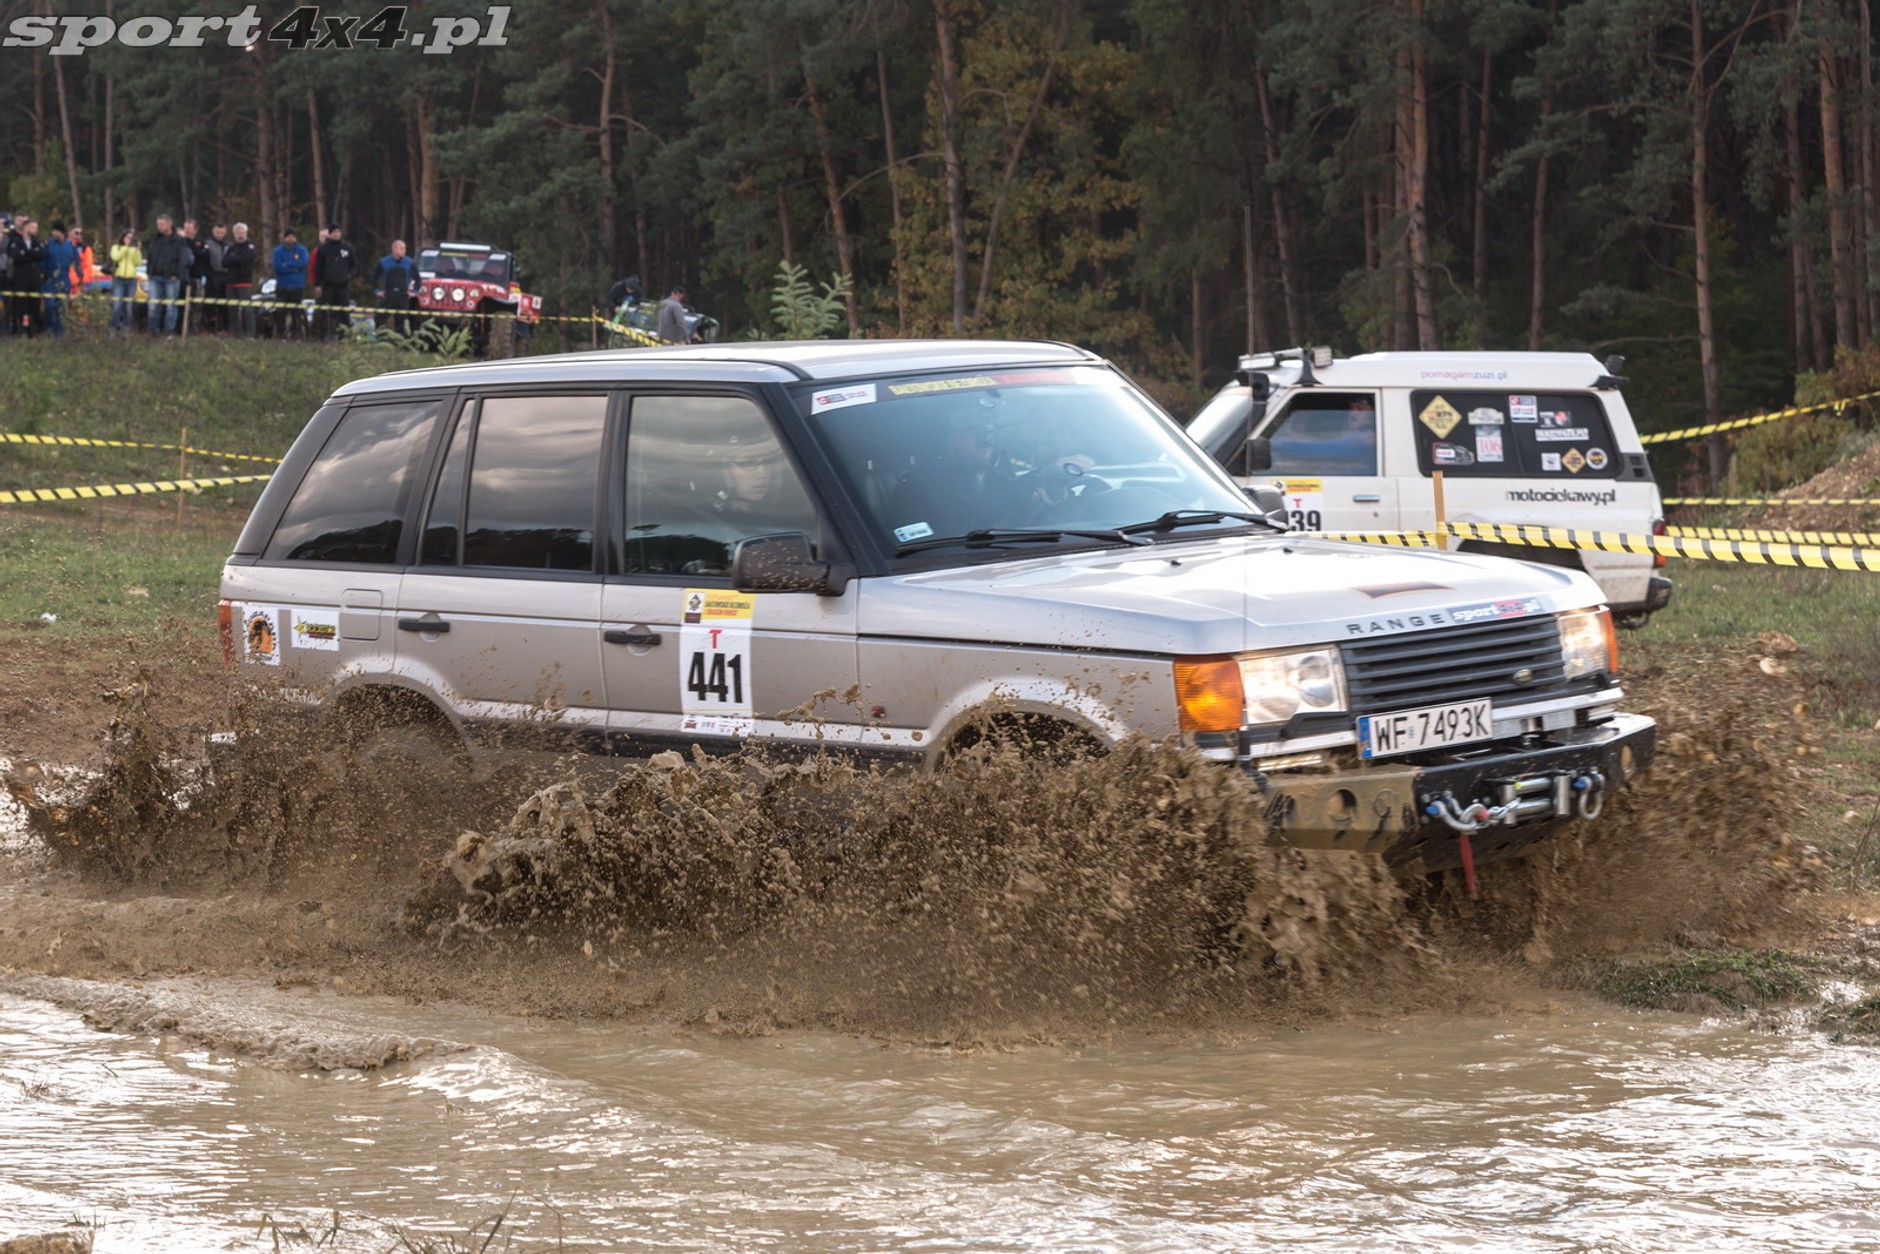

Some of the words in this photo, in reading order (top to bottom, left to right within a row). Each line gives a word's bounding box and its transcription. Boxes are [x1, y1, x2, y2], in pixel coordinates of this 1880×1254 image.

[1293, 498, 1303, 509] T
[1284, 510, 1321, 532] 39
[1346, 613, 1446, 635] RANGE
[709, 629, 723, 649] T
[687, 651, 743, 704] 441
[1374, 716, 1408, 752] WF
[1417, 703, 1489, 746] 7493K
